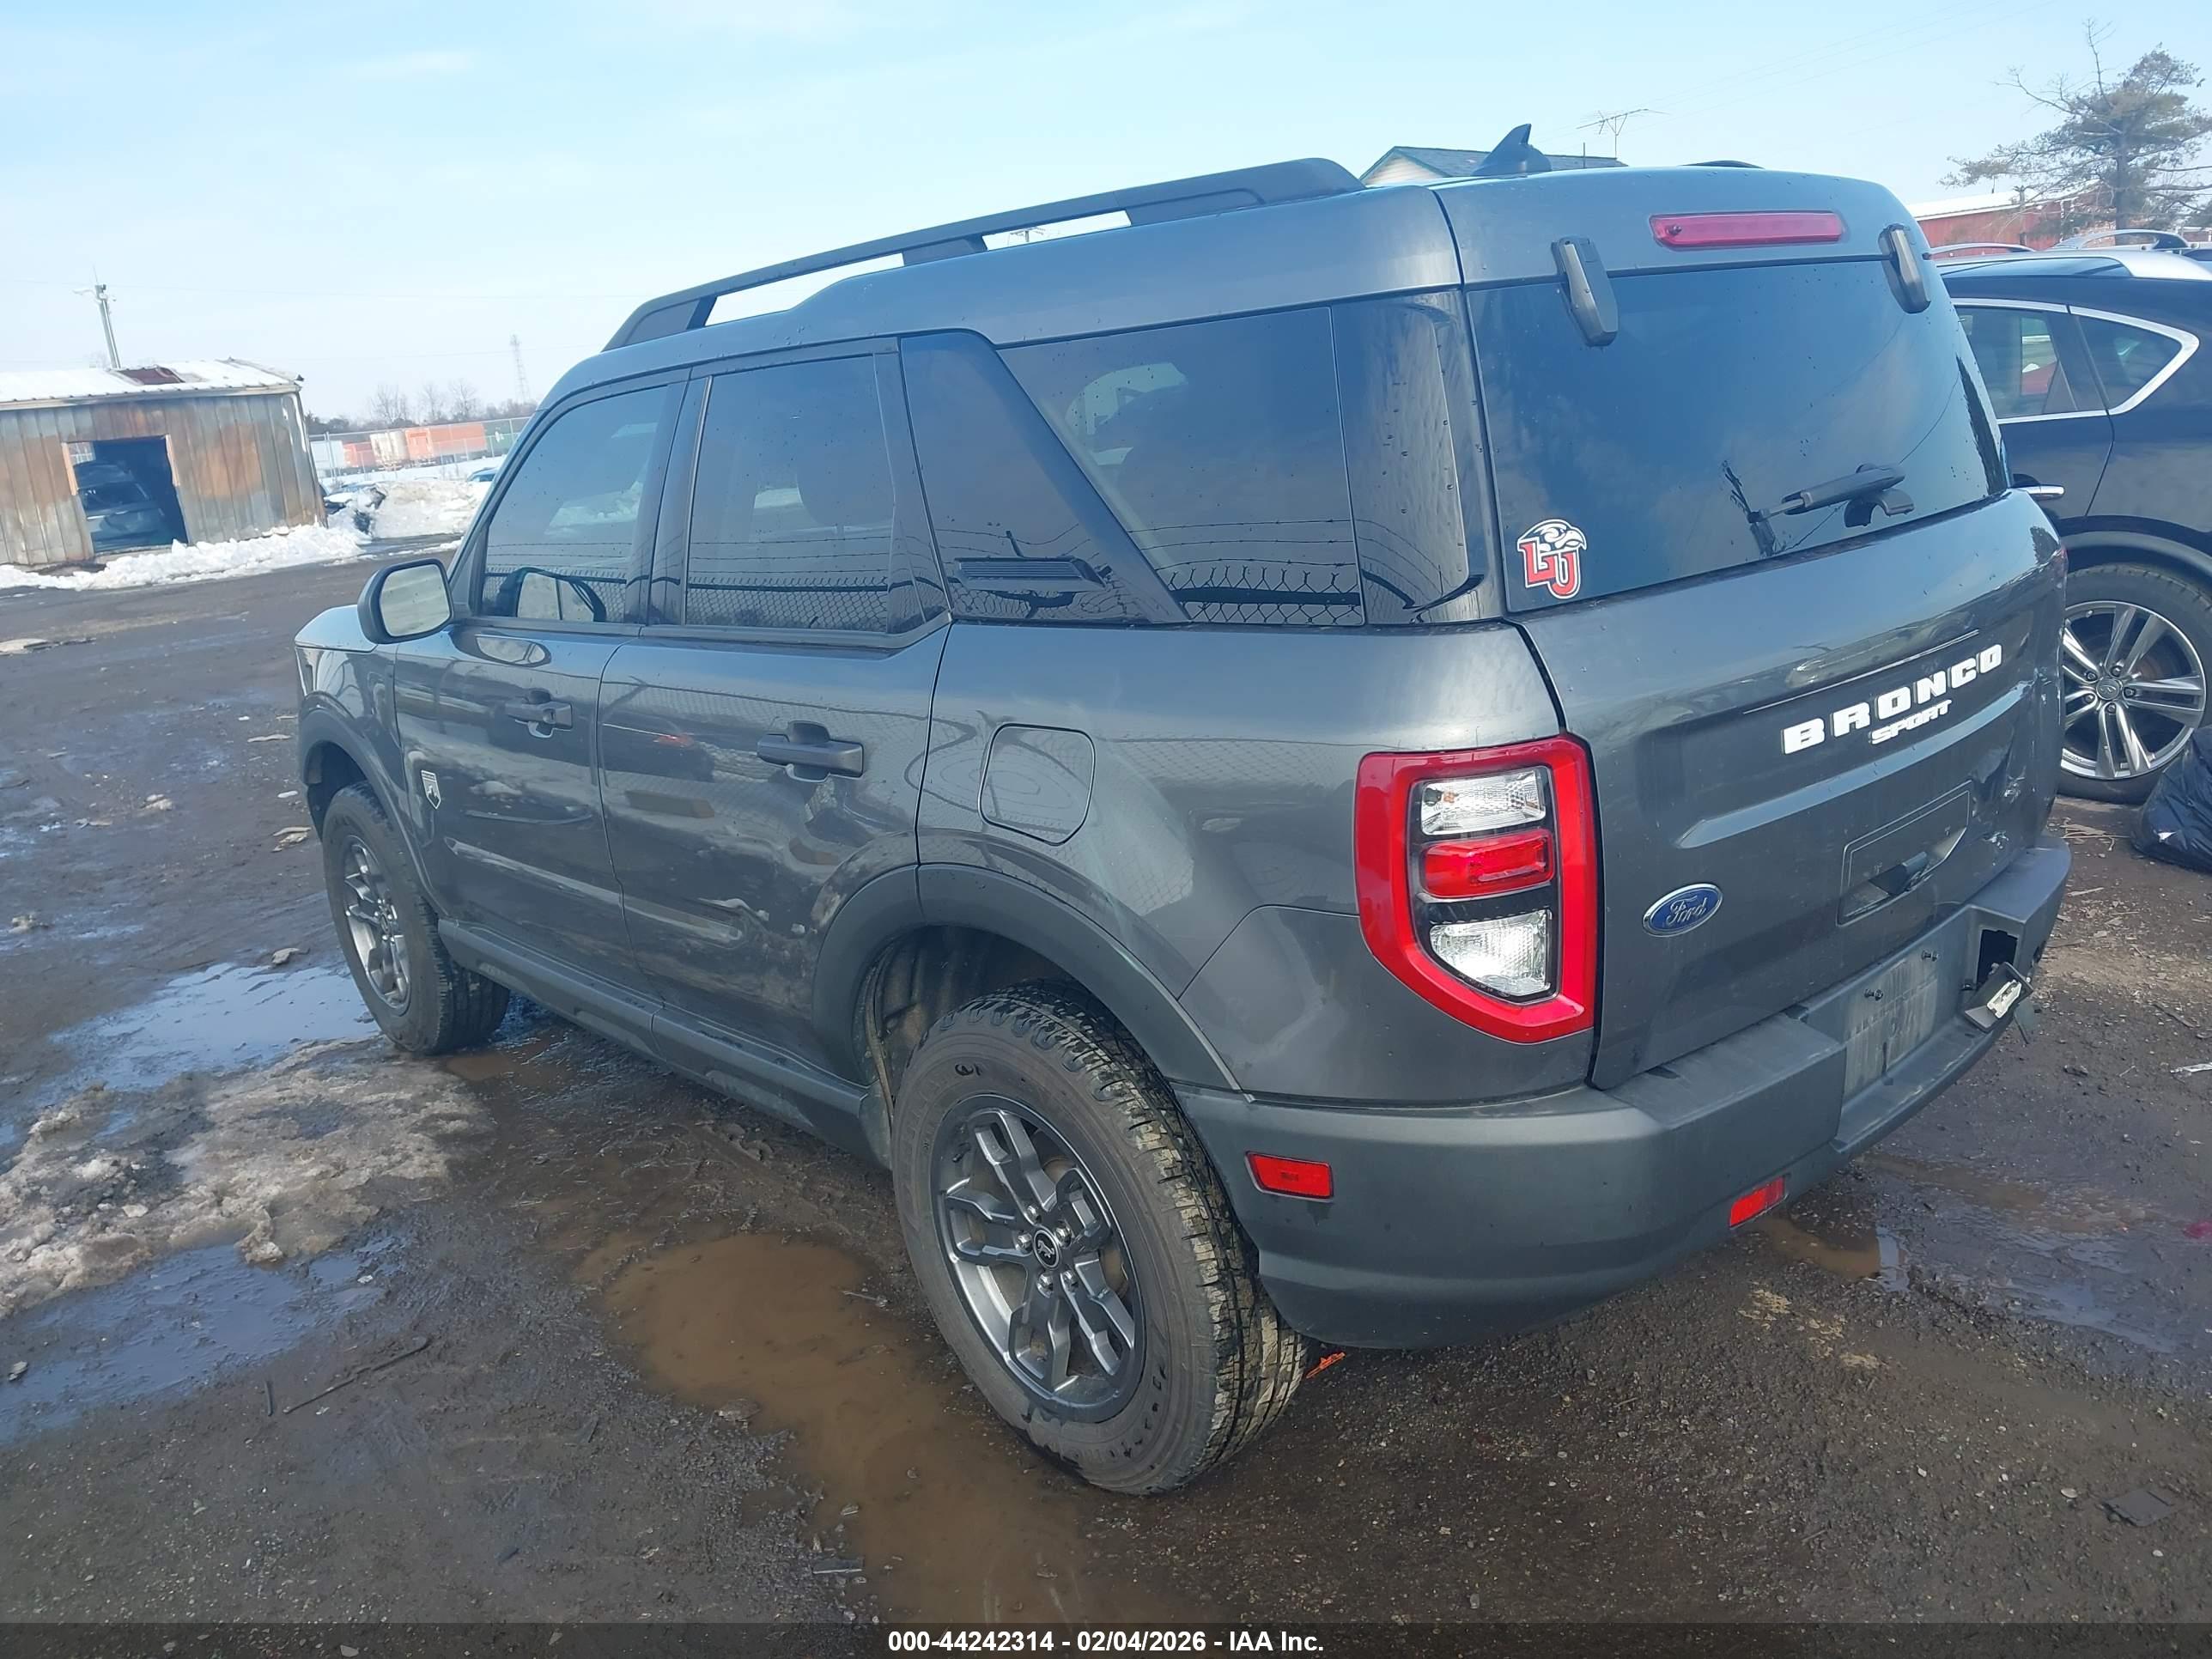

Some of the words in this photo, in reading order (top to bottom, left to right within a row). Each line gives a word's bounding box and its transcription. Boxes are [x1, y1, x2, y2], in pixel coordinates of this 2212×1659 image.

[1518, 538, 1580, 598] LU
[1781, 644, 2002, 755] BRONCO
[1869, 699, 1953, 744] SPORT
[1665, 895, 1708, 927] Ford
